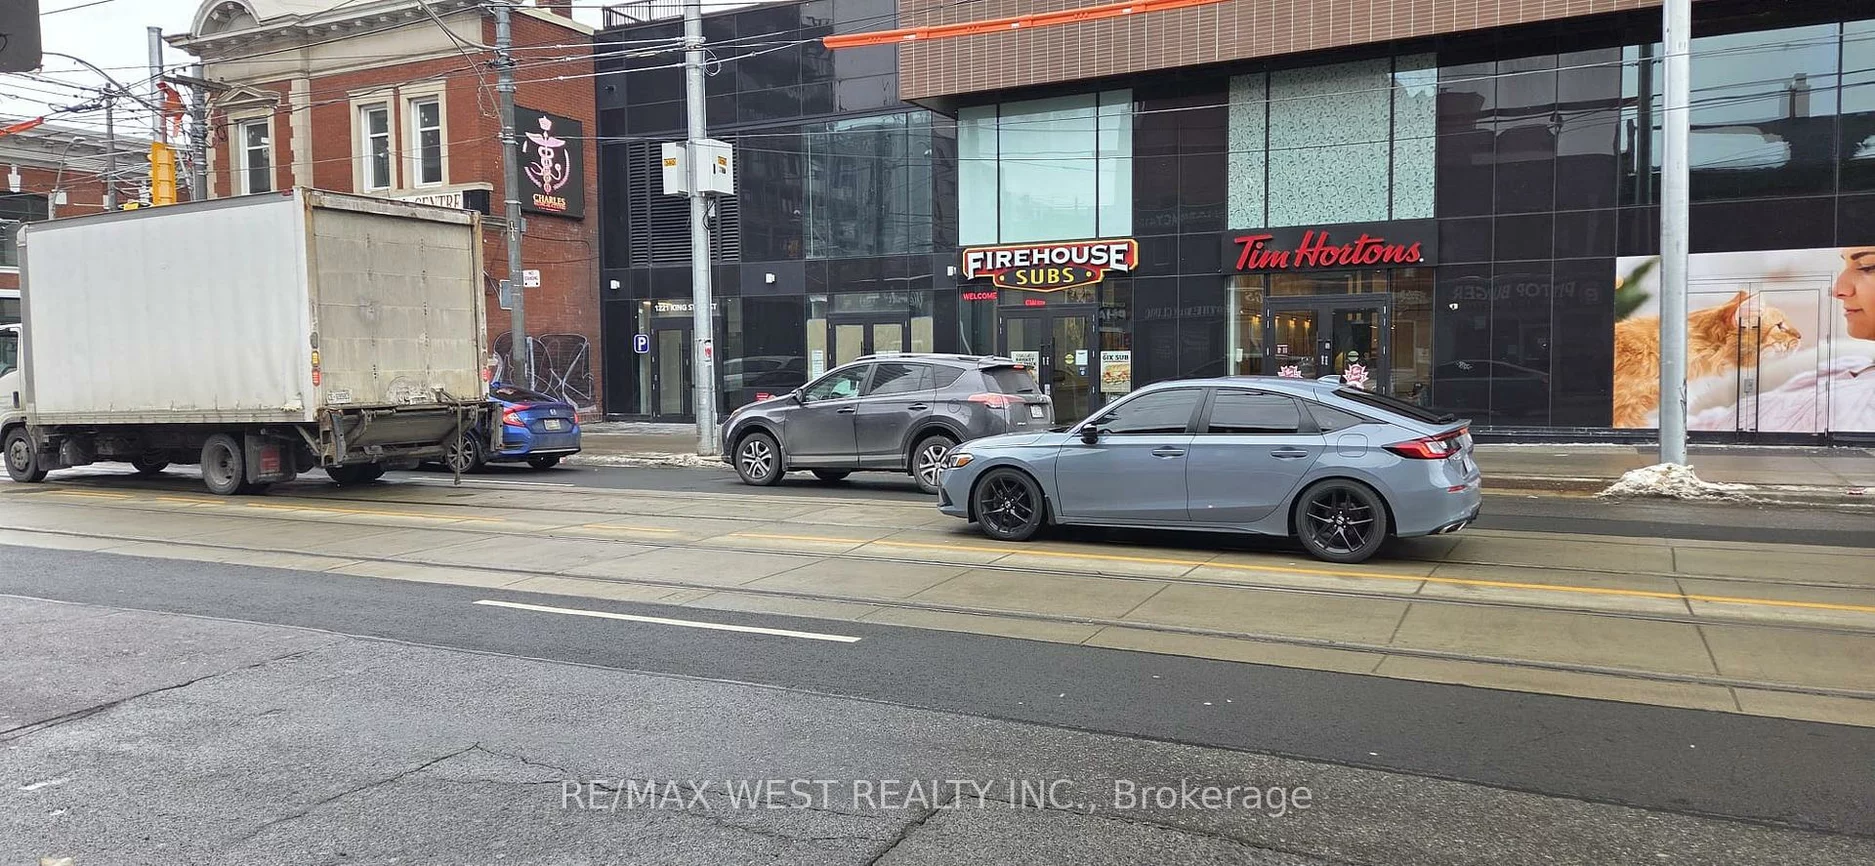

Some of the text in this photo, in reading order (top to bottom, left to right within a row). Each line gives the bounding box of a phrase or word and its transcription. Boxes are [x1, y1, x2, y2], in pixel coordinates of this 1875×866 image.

[533, 194, 566, 206] CHARLES
[1234, 230, 1422, 271] Tim Hortons
[967, 242, 1129, 280] FIREHOUSE
[1016, 267, 1075, 286] SUBS
[962, 291, 998, 300] WELCOME
[654, 304, 669, 312] 1221
[670, 303, 687, 312] KING
[637, 336, 647, 351] P
